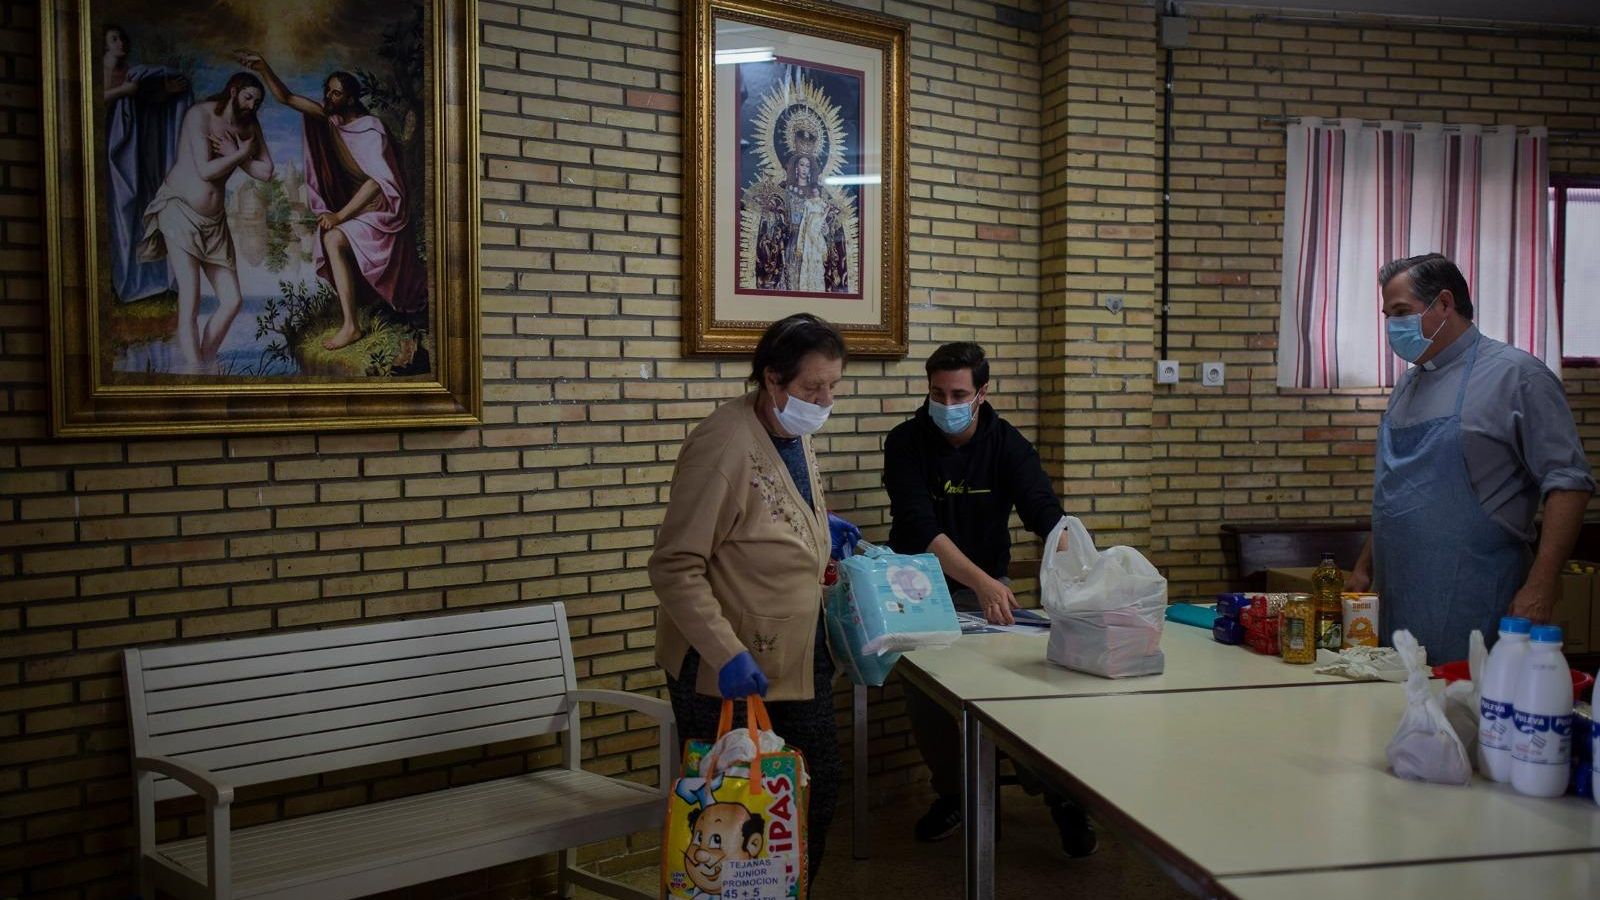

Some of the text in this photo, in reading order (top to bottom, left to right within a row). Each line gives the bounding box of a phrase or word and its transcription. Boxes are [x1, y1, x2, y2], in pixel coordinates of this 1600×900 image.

[1515, 712, 1545, 726] PULEVA
[730, 859, 771, 869] TEJANAS
[734, 869, 767, 878] JUNIOR
[723, 877, 778, 887] PROMOCION
[724, 889, 738, 898] 45
[753, 887, 760, 897] 5
